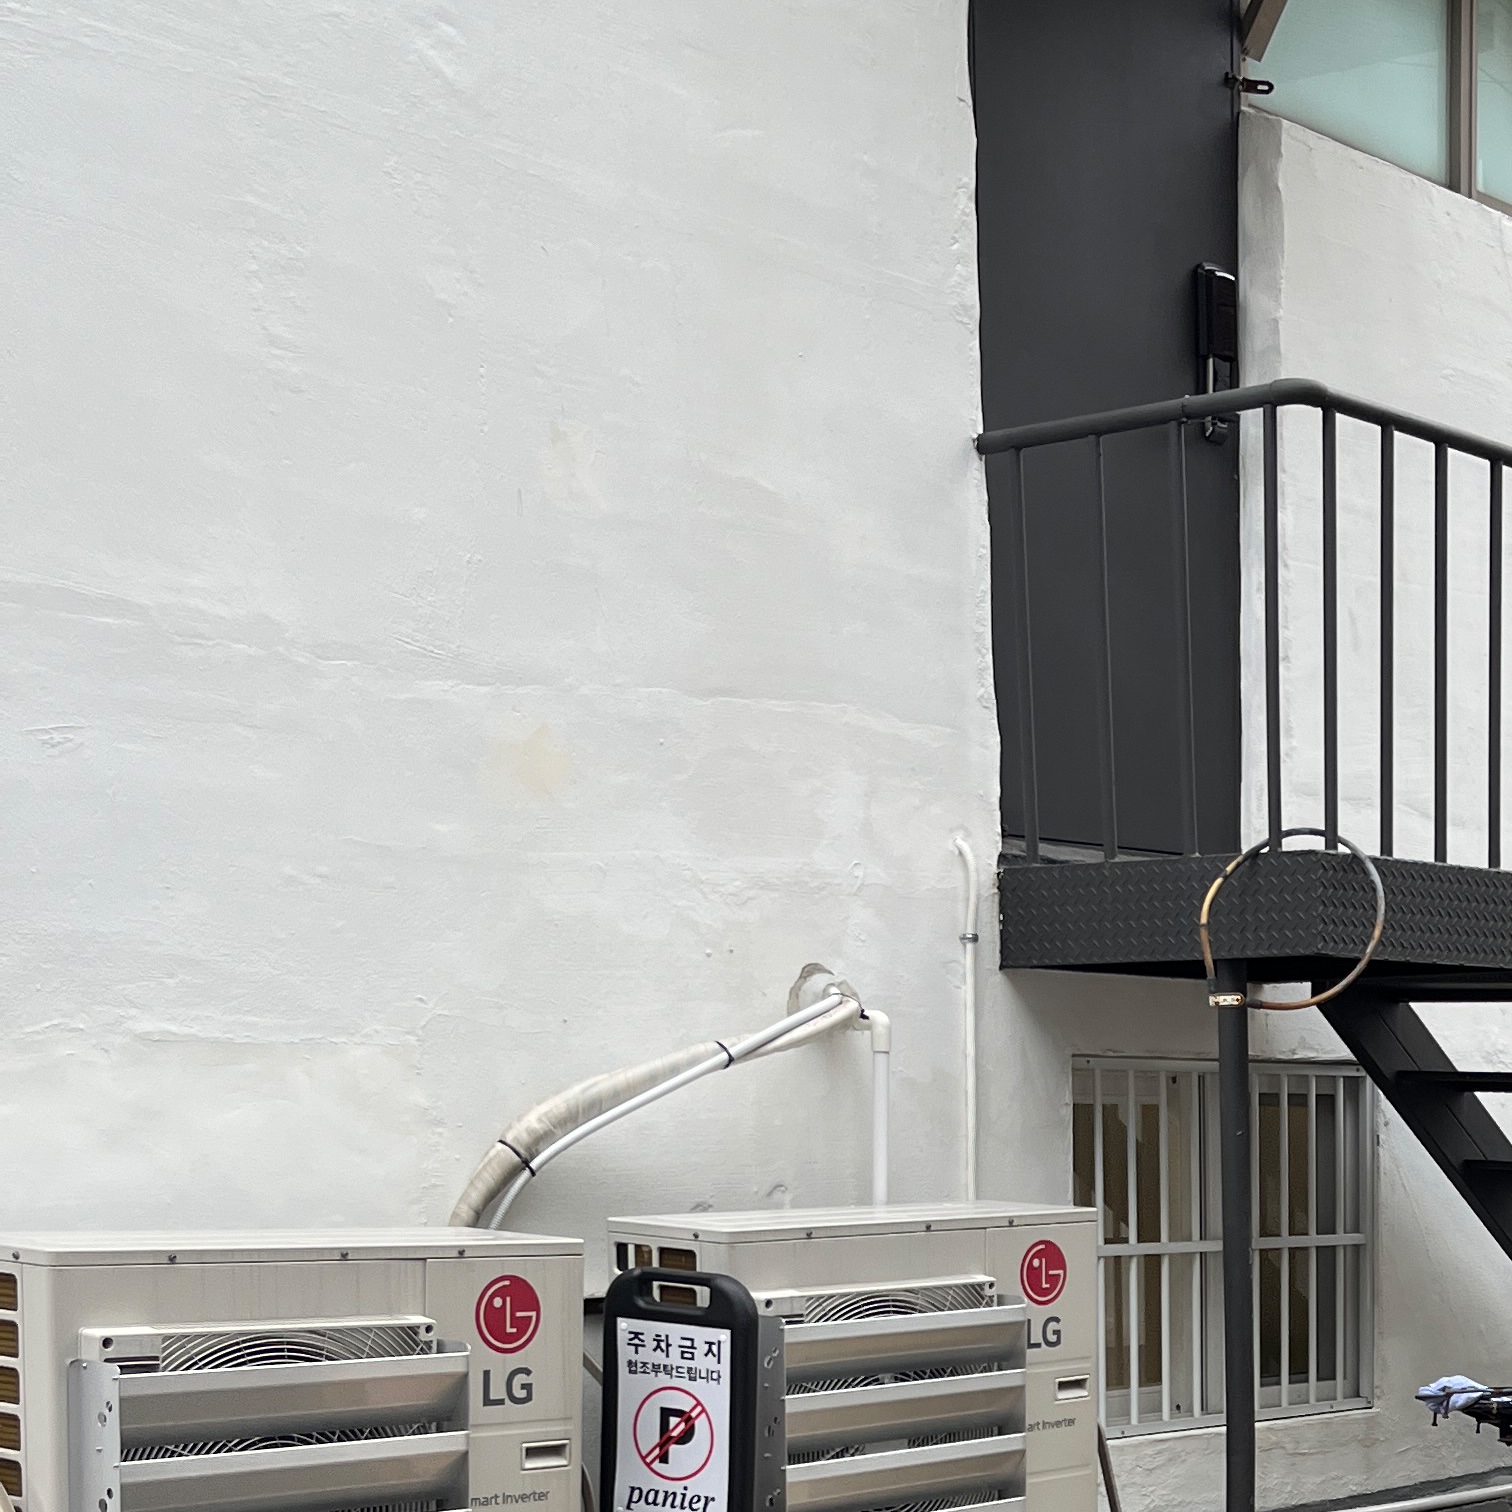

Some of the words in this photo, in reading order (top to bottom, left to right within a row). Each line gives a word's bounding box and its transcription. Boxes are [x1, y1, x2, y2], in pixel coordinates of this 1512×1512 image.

[626, 1330, 722, 1365] 주차금지
[1027, 1316, 1062, 1349] LG
[482, 1366, 533, 1407] LG
[626, 1358, 722, 1386] 협조부탁드립니다
[1027, 1420, 1040, 1432] art
[1042, 1415, 1077, 1431] Inverter
[470, 1493, 500, 1508] mart
[502, 1489, 550, 1505] Inverter
